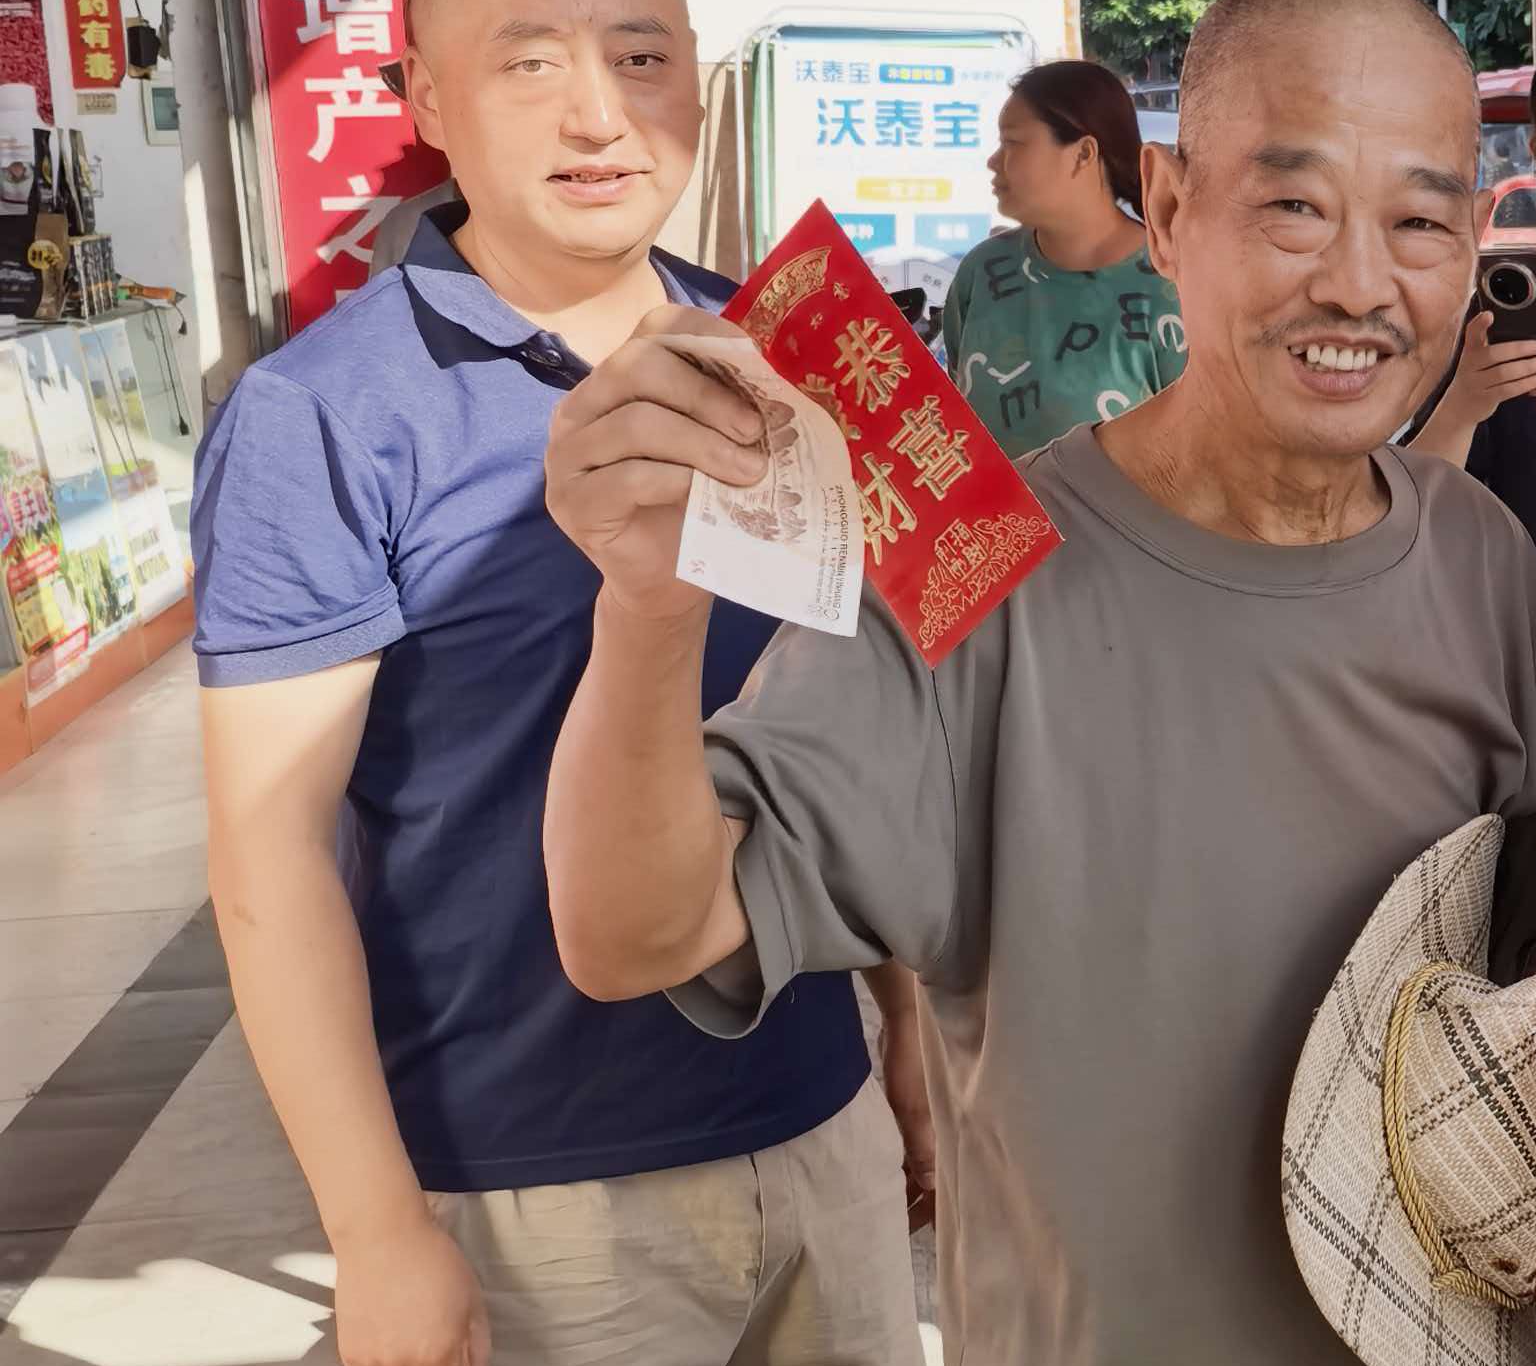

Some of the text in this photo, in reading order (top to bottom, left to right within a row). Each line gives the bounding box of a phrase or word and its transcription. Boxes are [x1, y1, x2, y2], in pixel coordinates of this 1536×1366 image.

[796, 60, 871, 84] 沃泰宝
[816, 97, 981, 148] 沃泰宝
[833, 316, 972, 502] 恭喜
